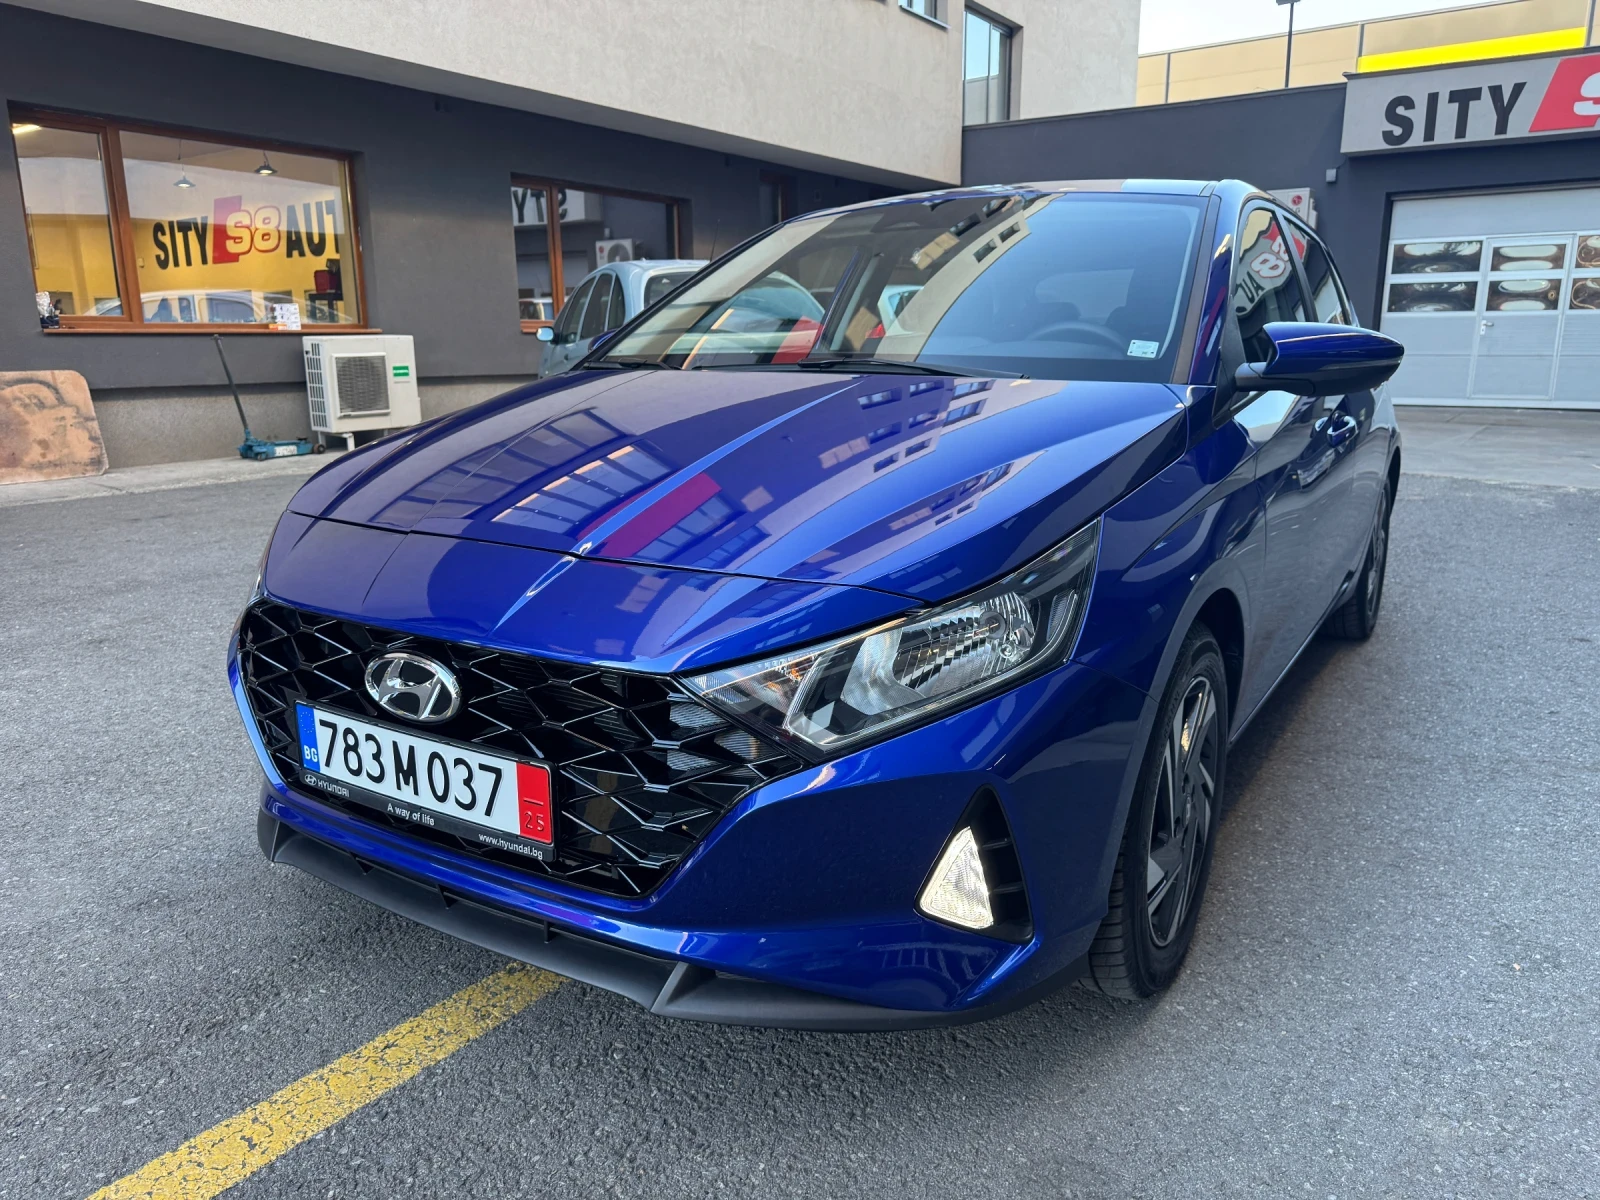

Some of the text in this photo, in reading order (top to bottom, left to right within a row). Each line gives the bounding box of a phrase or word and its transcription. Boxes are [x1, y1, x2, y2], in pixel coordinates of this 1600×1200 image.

[1382, 82, 1527, 146] SITY
[153, 216, 208, 270] SITY
[226, 205, 282, 256] S8
[303, 744, 318, 763] BG
[317, 779, 350, 798] HYUNDAI
[387, 803, 435, 826] A way of life
[524, 811, 545, 831] 25
[478, 833, 543, 860] www.hyundai.bg
